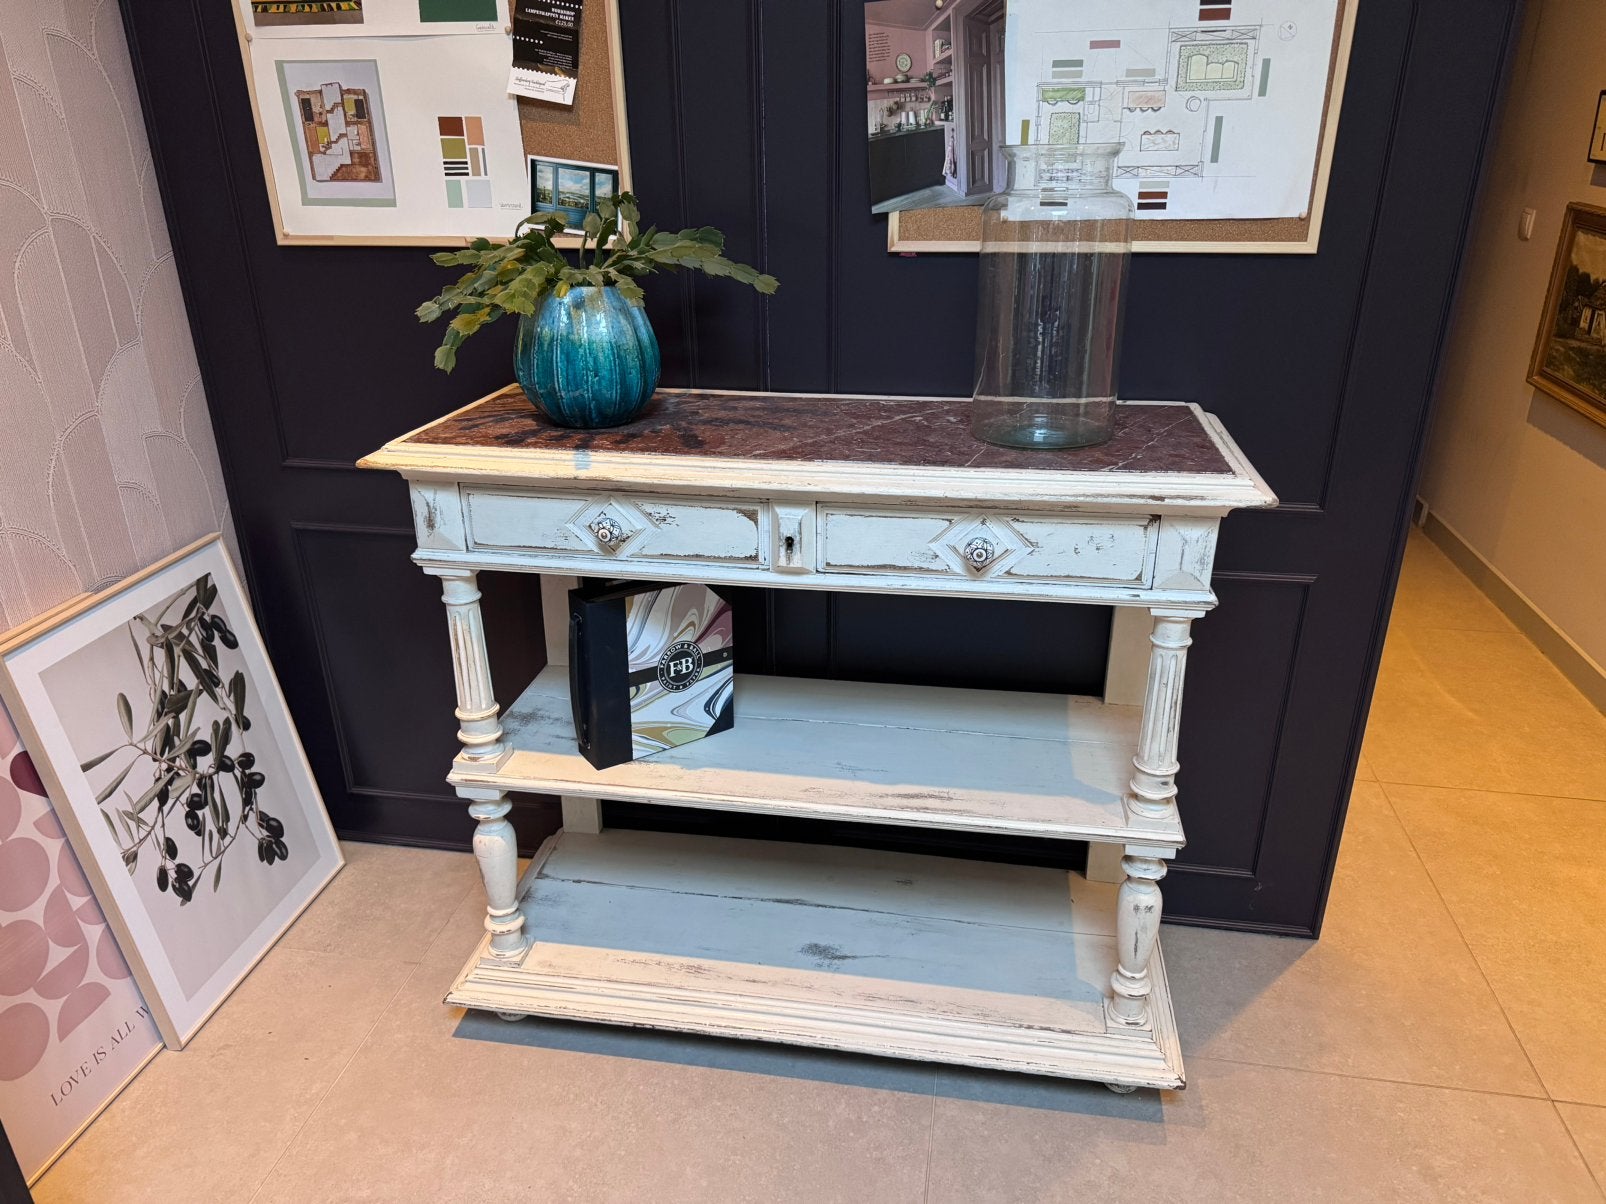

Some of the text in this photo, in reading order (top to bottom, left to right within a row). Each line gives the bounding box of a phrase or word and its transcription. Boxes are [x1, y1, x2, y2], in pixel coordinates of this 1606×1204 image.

[660, 644, 682, 668] FARROW
[689, 645, 700, 659] BALL
[669, 657, 694, 678] F&B
[50, 1006, 149, 1106] LOVE IS ALL W
